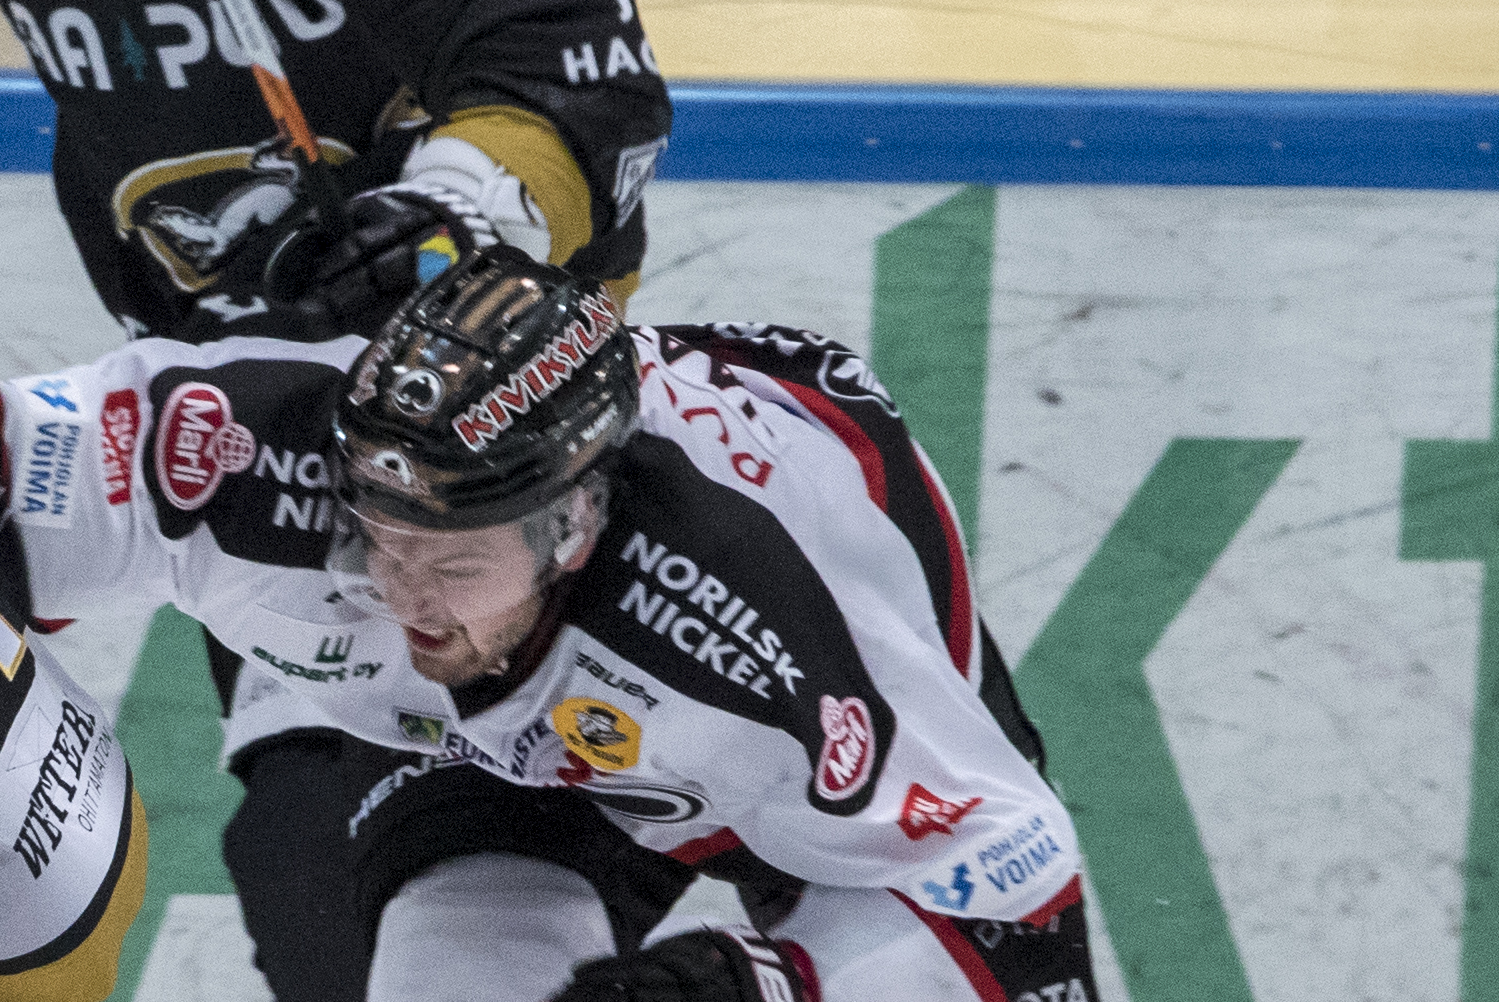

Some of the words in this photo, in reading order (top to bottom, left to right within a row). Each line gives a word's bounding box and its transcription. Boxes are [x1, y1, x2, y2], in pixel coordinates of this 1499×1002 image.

[22, 421, 60, 514] VOIMA
[618, 580, 772, 700] NICKEL
[619, 531, 805, 696] NORILSK
[985, 834, 1061, 893] VOIMA
